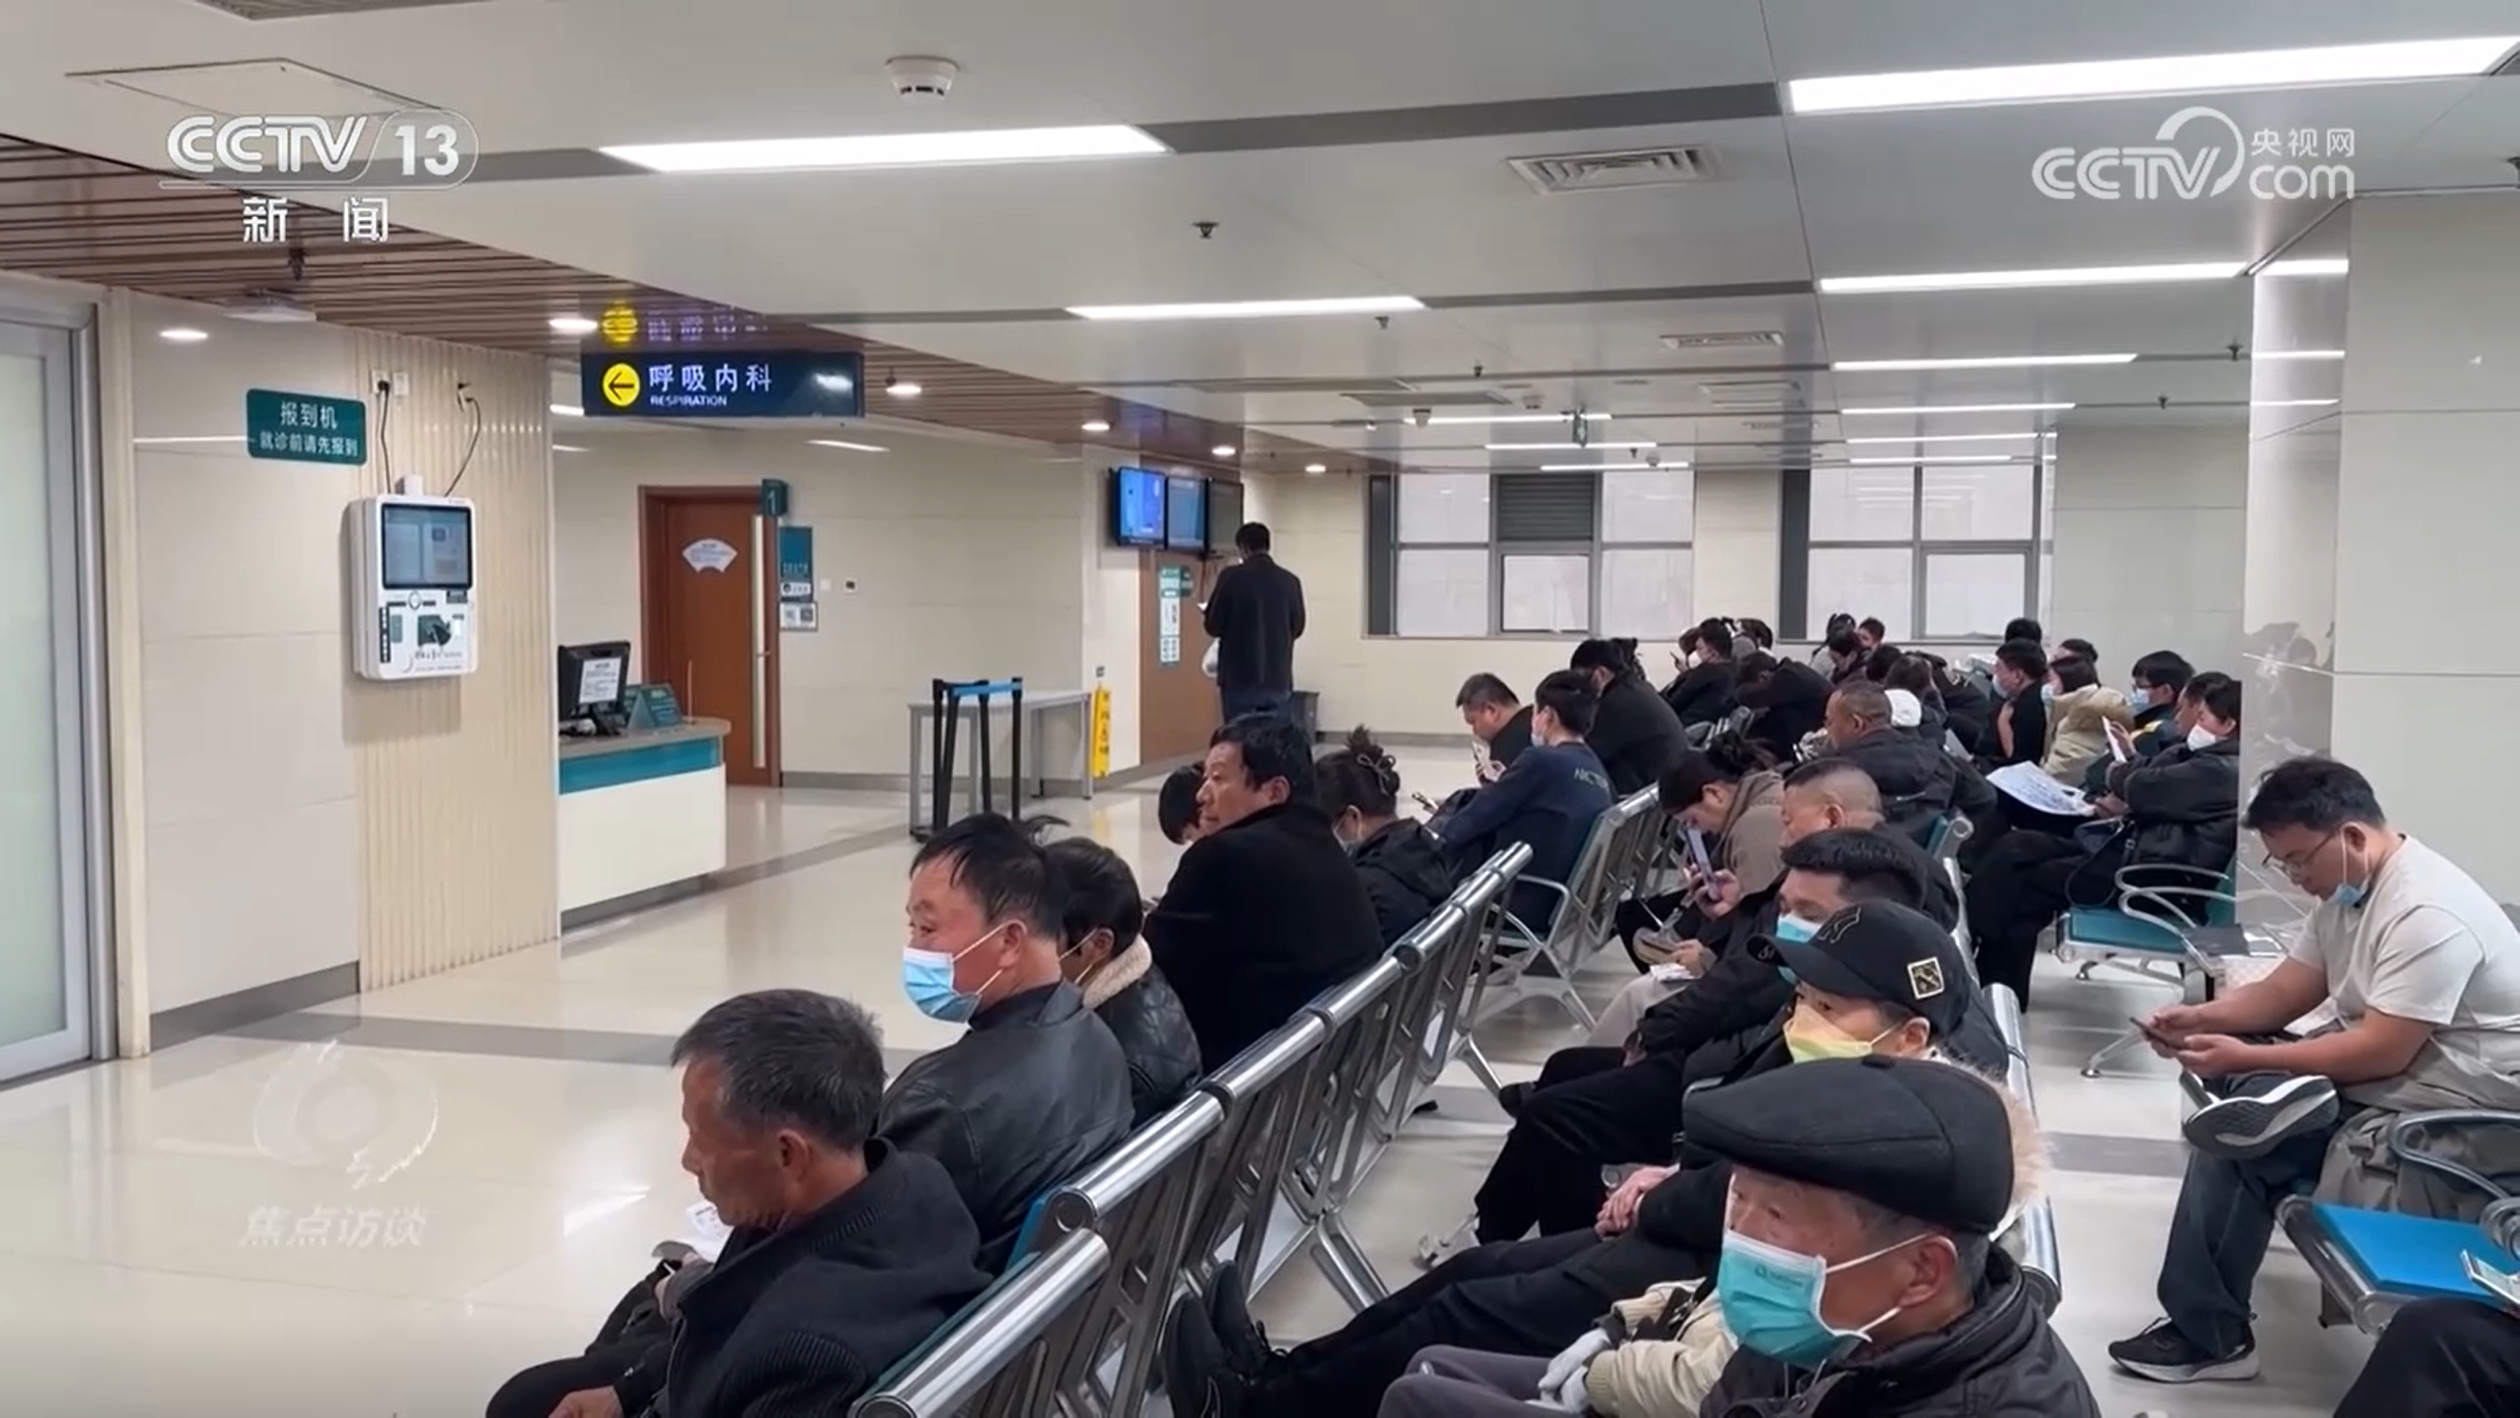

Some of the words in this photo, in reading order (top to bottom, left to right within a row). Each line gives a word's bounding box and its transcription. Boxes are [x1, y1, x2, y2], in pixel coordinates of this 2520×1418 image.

[649, 364, 772, 392] 呼吸内科
[650, 394, 727, 406] RESPIRATION
[281, 401, 337, 430] 报到机
[260, 431, 358, 457] 就诊前请先报到
